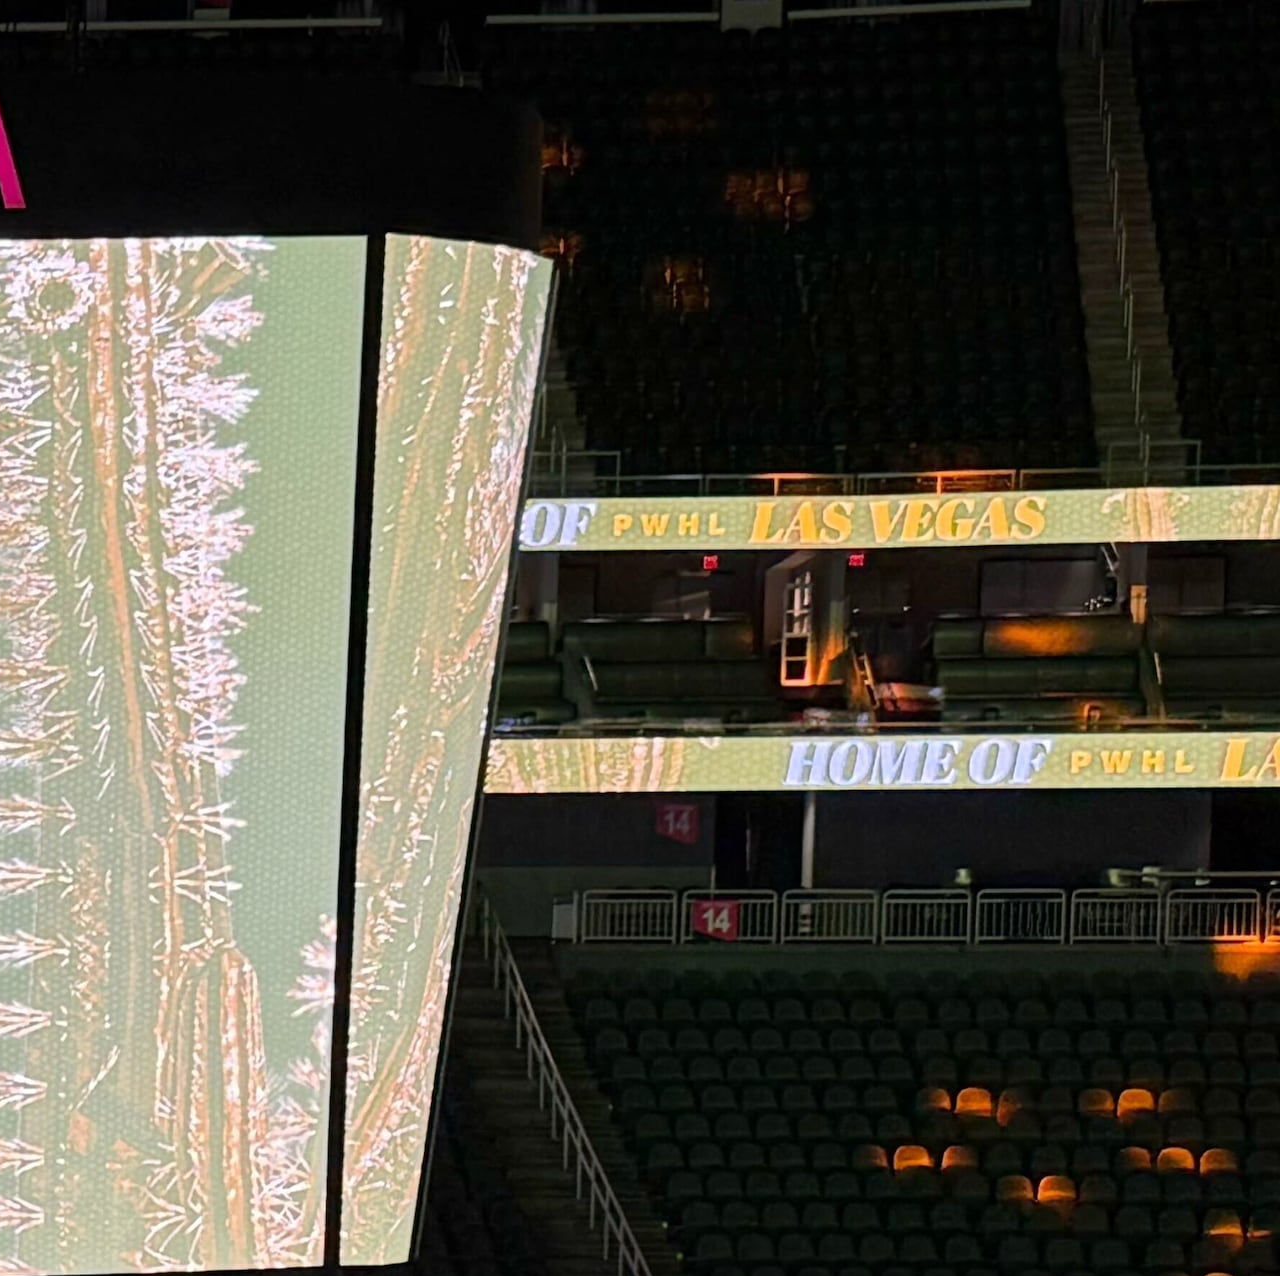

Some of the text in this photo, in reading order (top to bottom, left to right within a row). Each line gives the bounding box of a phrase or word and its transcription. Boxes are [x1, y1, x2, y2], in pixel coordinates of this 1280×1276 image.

[523, 495, 1046, 547] OF PWHL LAS VEGAS
[781, 739, 963, 787] HOME
[968, 737, 1053, 786] OF
[1069, 749, 1196, 775] PWHL
[663, 811, 690, 836] 14
[701, 907, 731, 934] 14
